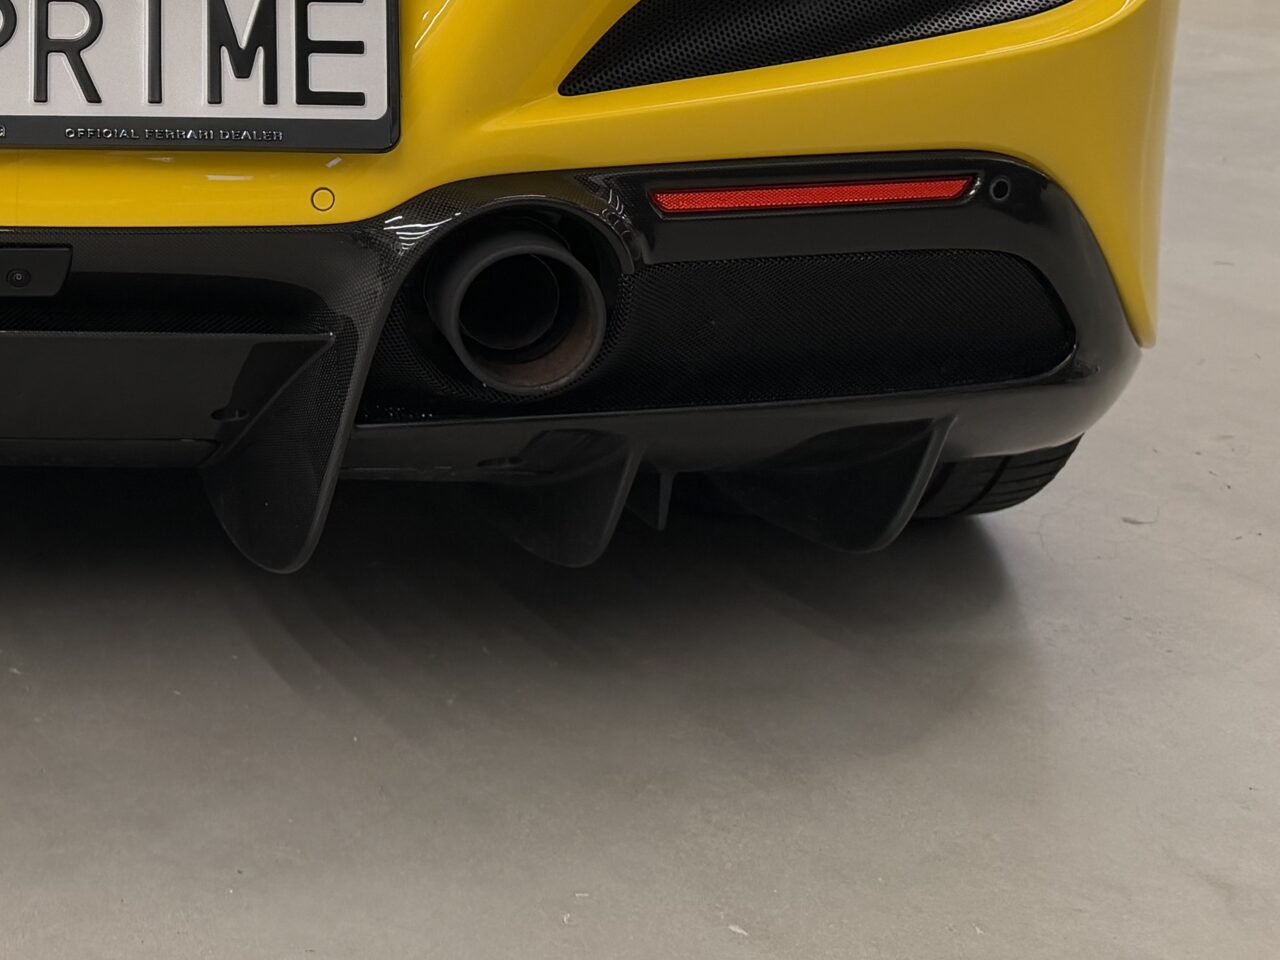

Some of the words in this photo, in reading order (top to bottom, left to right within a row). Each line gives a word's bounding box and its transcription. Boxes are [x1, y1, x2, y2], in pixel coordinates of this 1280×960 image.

[65, 128, 139, 139] OFFICIAL
[145, 129, 214, 140] FERRARI
[219, 129, 283, 141] DEALER
